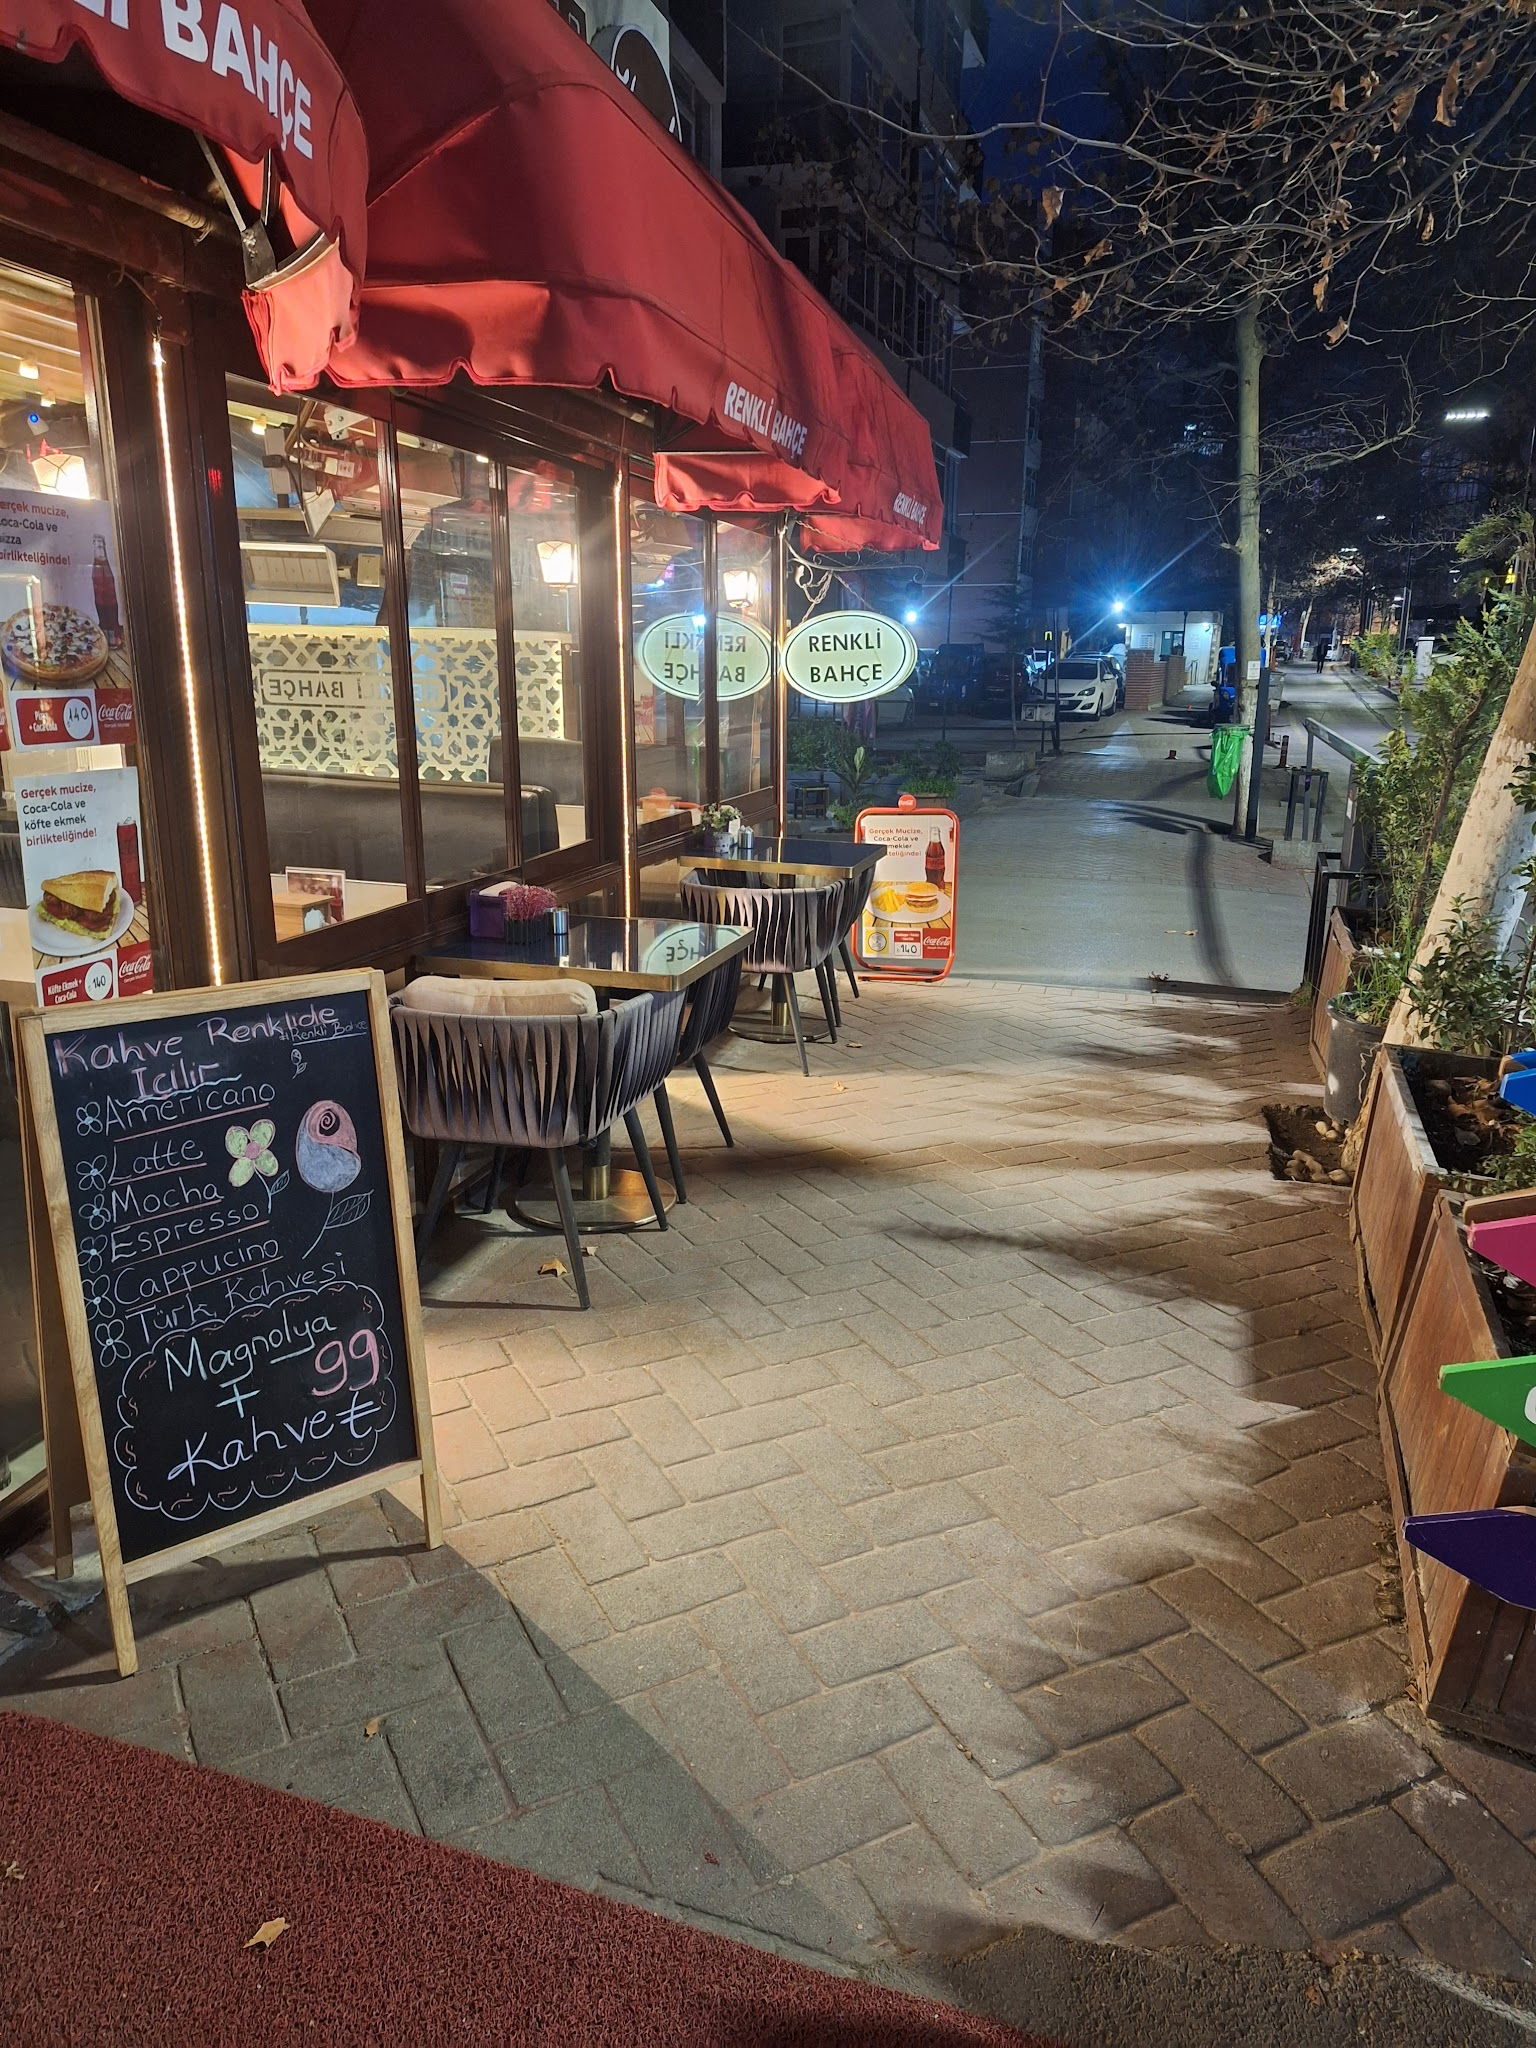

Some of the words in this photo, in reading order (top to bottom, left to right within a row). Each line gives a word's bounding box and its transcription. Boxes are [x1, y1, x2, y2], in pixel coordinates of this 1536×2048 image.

[160, 0, 313, 159] BAHÇE
[724, 381, 774, 436] RENKLİ
[771, 409, 808, 459] BAHÇE
[0, 501, 29, 514] erçek
[31, 505, 69, 519] mucize,
[0, 517, 44, 531] oca-Cola
[46, 523, 58, 532] ve
[809, 628, 882, 653] RENKLİ
[810, 664, 882, 687] BAHÇE
[68, 707, 88, 721] 140
[98, 703, 133, 722] Coca-Cola
[21, 786, 57, 800] Gerçek
[60, 783, 96, 796] mucize,
[23, 801, 72, 815] Coca-Cola
[74, 800, 86, 808] ve
[24, 819, 51, 831] köfte
[54, 814, 86, 827] ekmek
[26, 828, 97, 847] birlikteliğinde!
[900, 944, 918, 954] 140
[923, 936, 950, 946] Coca-Cola
[118, 953, 151, 978] Coca-Cola
[92, 975, 107, 989] 140
[53, 1031, 184, 1078] Kahve
[197, 1003, 339, 1046] Renklide
[106, 1083, 275, 1136] Americano
[108, 1139, 203, 1182] Latte
[112, 1176, 224, 1224] Mocha
[111, 1203, 260, 1263] Espresso
[114, 1239, 279, 1305] Cappucino
[125, 1293, 217, 1344] Türk
[222, 1252, 346, 1313] Kahvesi
[164, 1309, 338, 1392] Magnolya
[167, 1414, 334, 1487] Kahve
